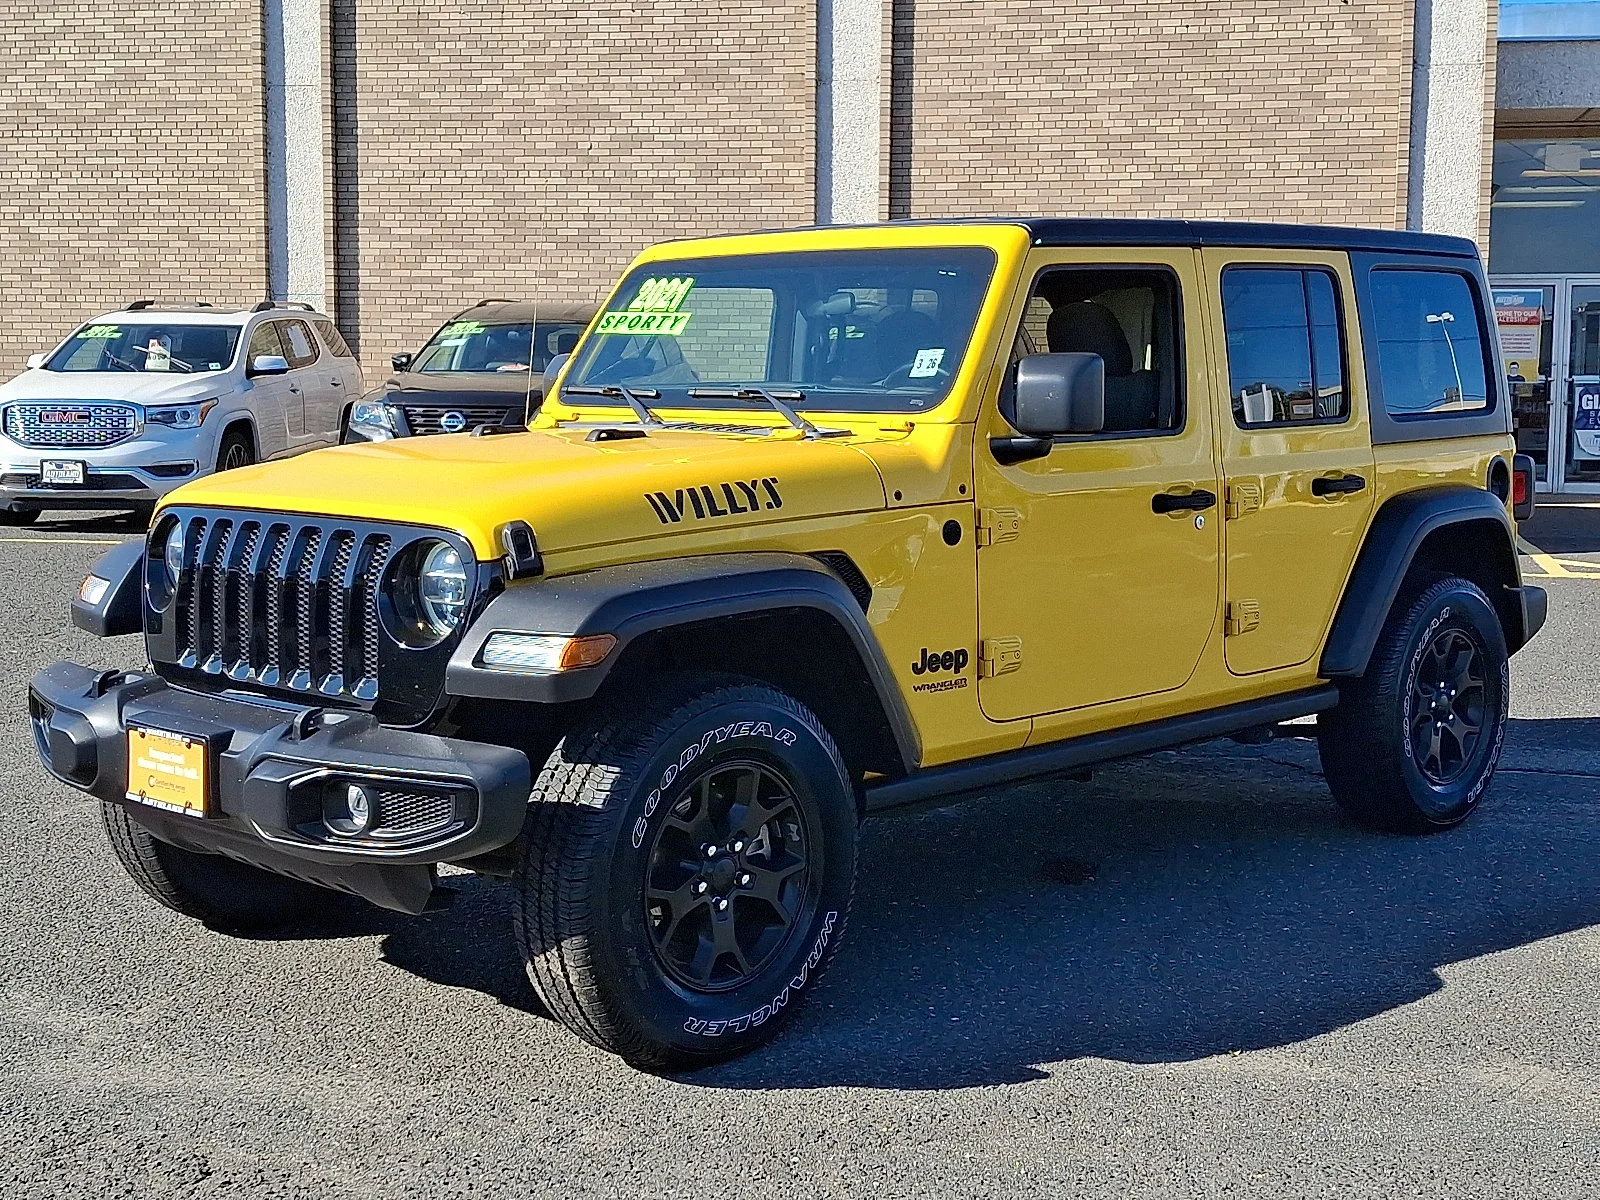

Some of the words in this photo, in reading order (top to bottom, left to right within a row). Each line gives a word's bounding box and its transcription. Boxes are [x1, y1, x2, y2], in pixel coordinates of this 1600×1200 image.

[628, 277, 696, 312] 2021
[600, 314, 687, 331] SPORTY
[917, 358, 924, 369] 3
[926, 358, 938, 369] 26
[1581, 393, 1600, 410] GI
[41, 411, 90, 423] GMC
[643, 477, 783, 524] WILLYS
[911, 647, 969, 675] Jeep
[912, 677, 968, 693] WRANGLER
[631, 721, 798, 849] GOODYEAR
[683, 911, 838, 1037] WRANGLER
